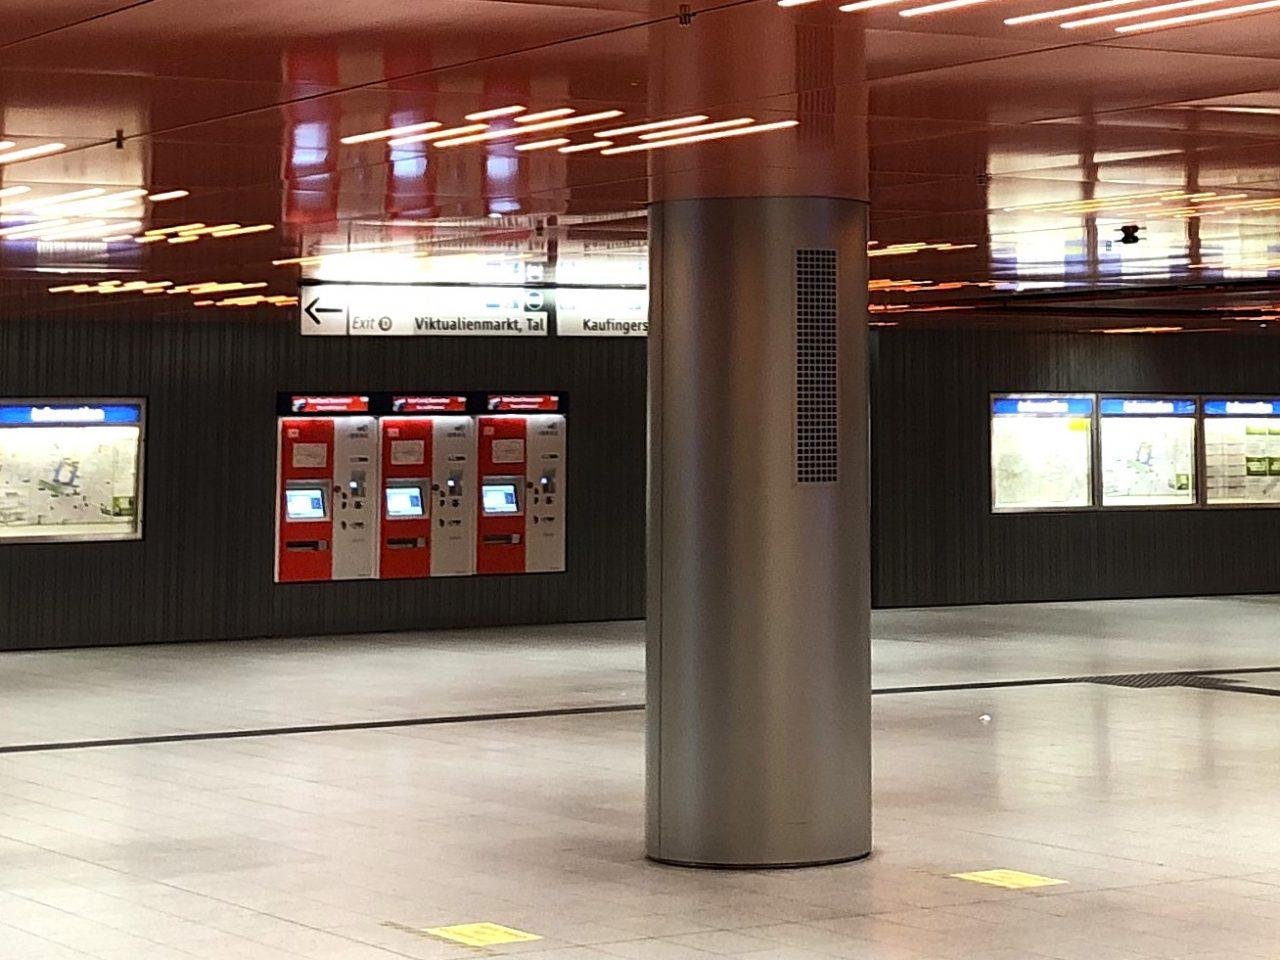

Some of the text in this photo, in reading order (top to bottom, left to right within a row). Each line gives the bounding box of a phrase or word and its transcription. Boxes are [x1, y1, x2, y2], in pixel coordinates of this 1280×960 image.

[352, 316, 545, 334] Exit Viktualienmarkt, Tal
